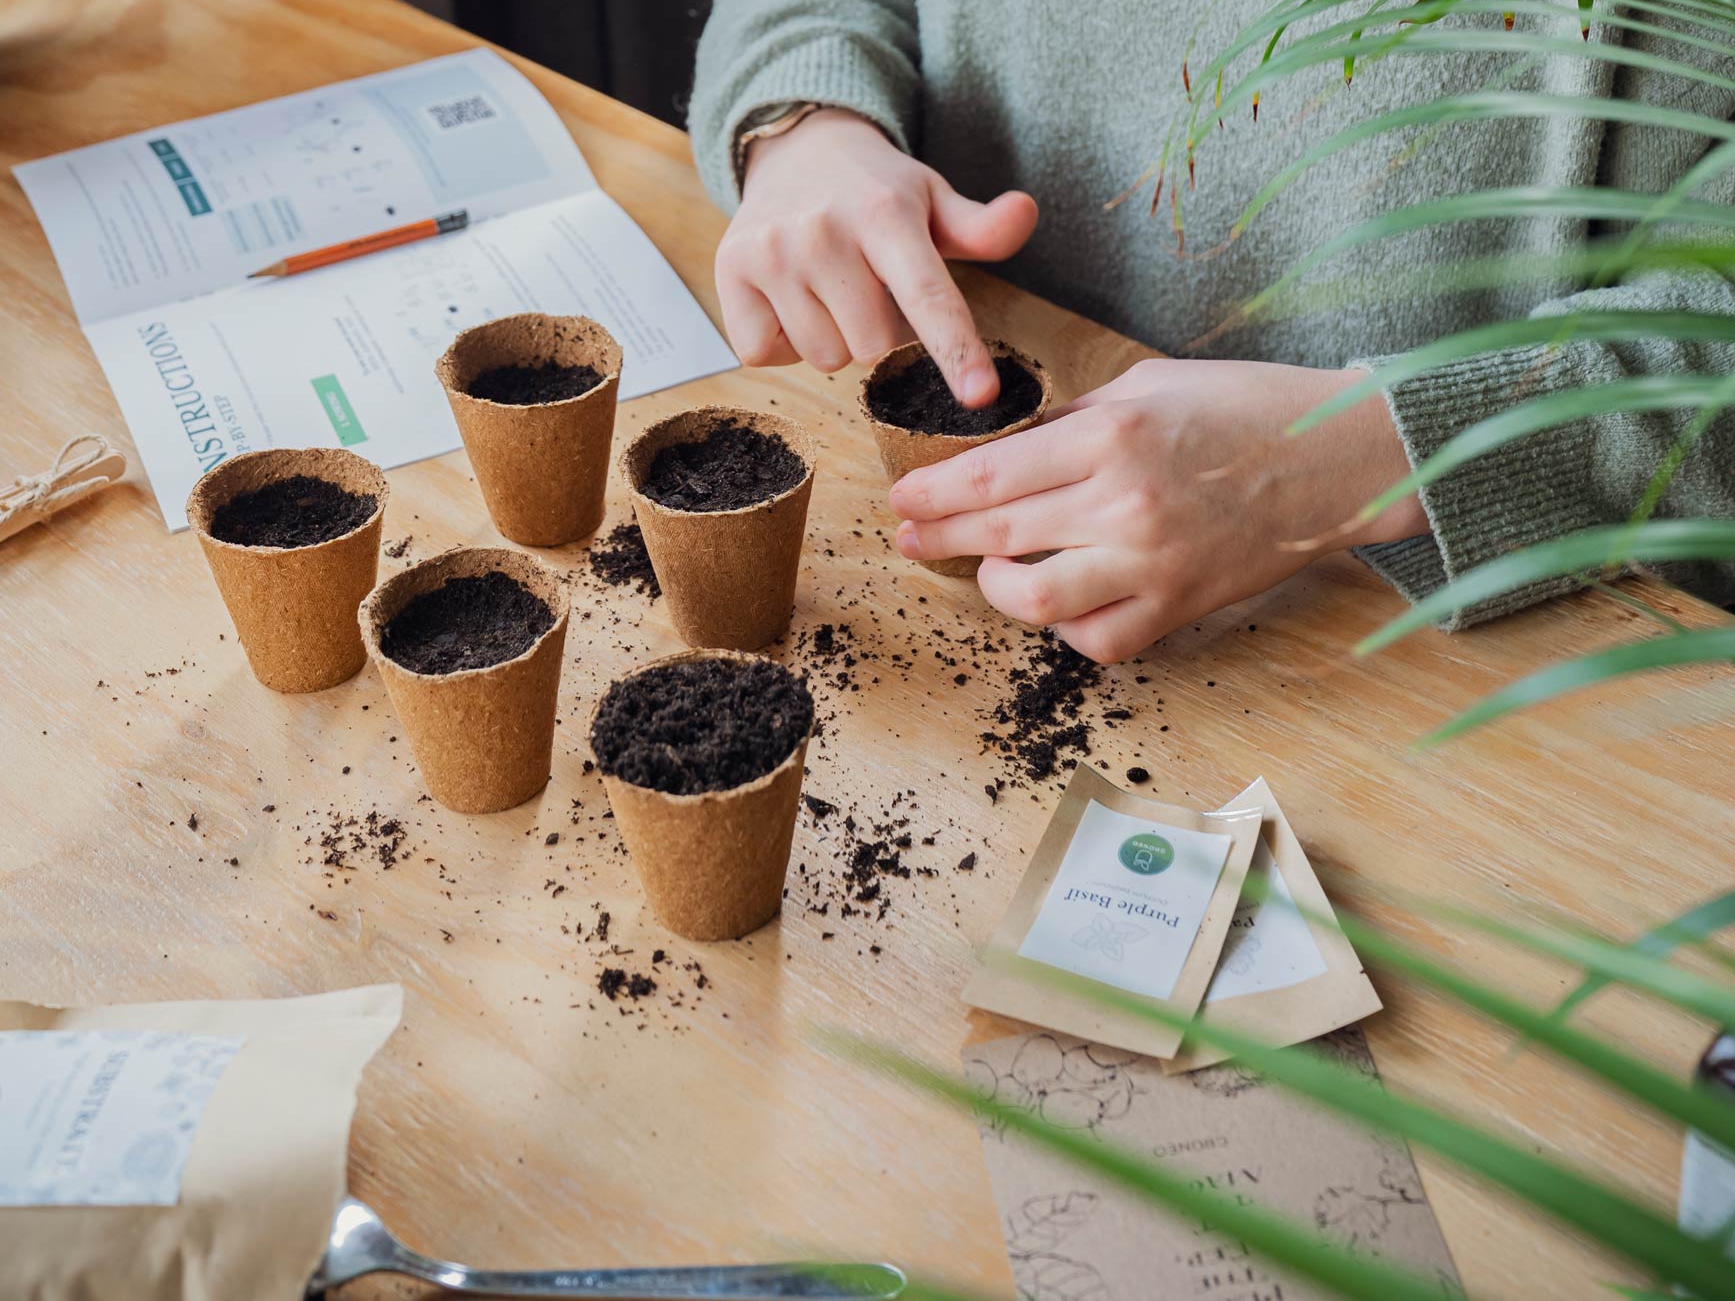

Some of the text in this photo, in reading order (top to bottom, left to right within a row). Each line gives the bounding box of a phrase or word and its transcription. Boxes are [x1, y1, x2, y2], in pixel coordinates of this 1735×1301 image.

[137, 321, 228, 473] NSTRUCTIONS
[1063, 888, 1112, 909] Basil
[1118, 899, 1181, 928] Purple
